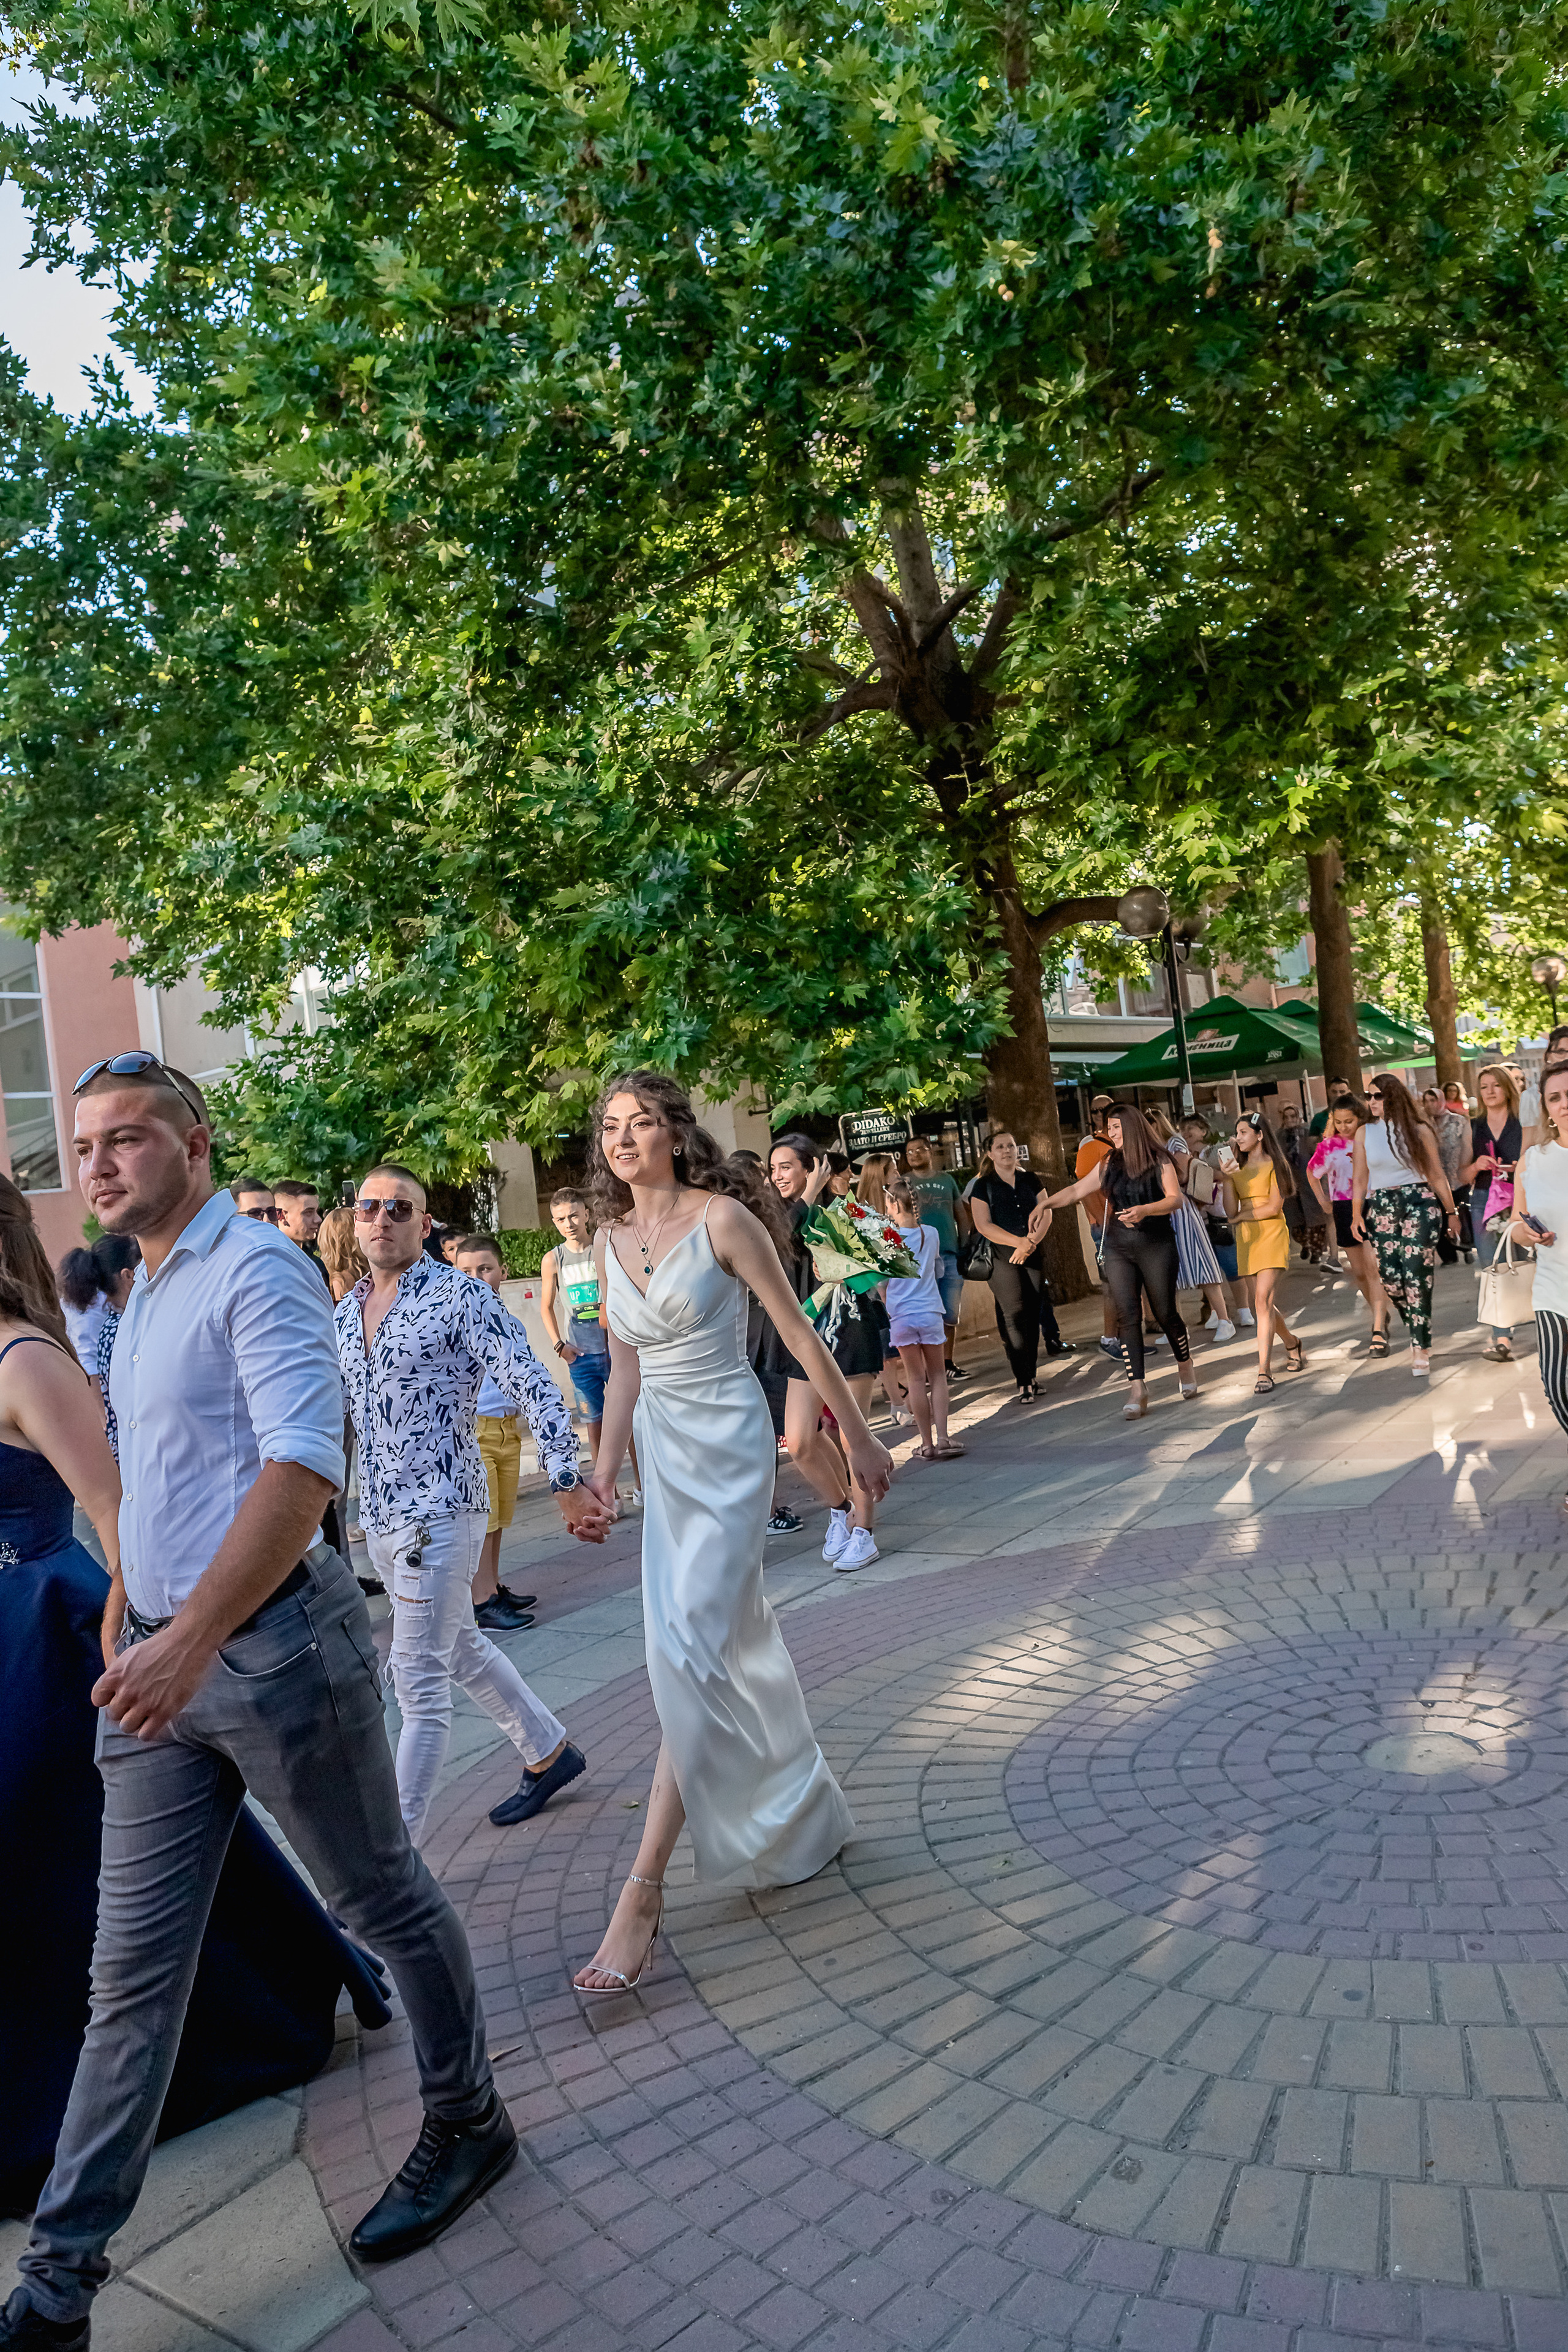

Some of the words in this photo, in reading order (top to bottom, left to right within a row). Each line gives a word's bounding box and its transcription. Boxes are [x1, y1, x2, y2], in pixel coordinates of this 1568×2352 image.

[853, 1116, 895, 1131] DIDAKO
[860, 1126, 890, 1135] JEWELLERY
[848, 1136, 870, 1147] ЗЛАТО
[878, 1131, 907, 1142] СРЕБРО
[570, 1291, 581, 1300] UP
